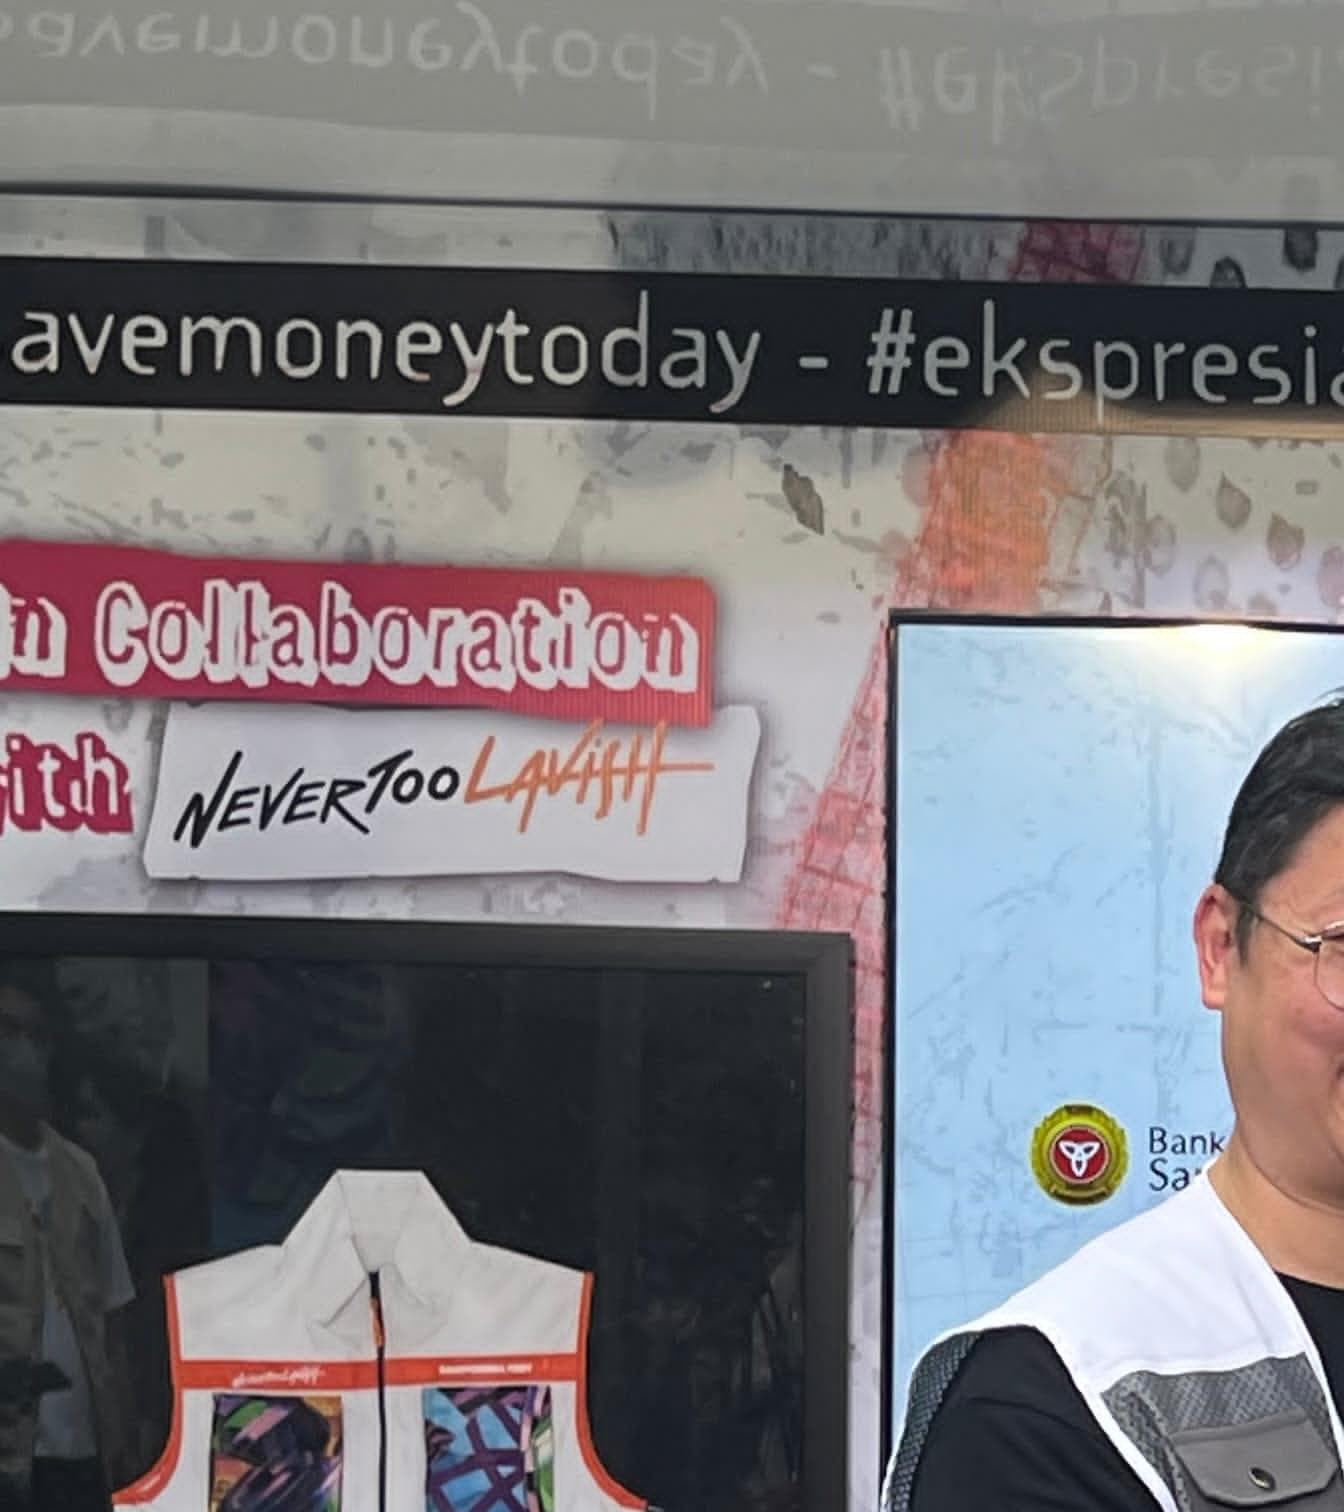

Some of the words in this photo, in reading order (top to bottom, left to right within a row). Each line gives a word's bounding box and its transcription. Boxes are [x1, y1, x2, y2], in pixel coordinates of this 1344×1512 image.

[95, 580, 699, 693] Collaboration
[0, 732, 133, 834] ith
[1148, 1126, 1226, 1155] Bank
